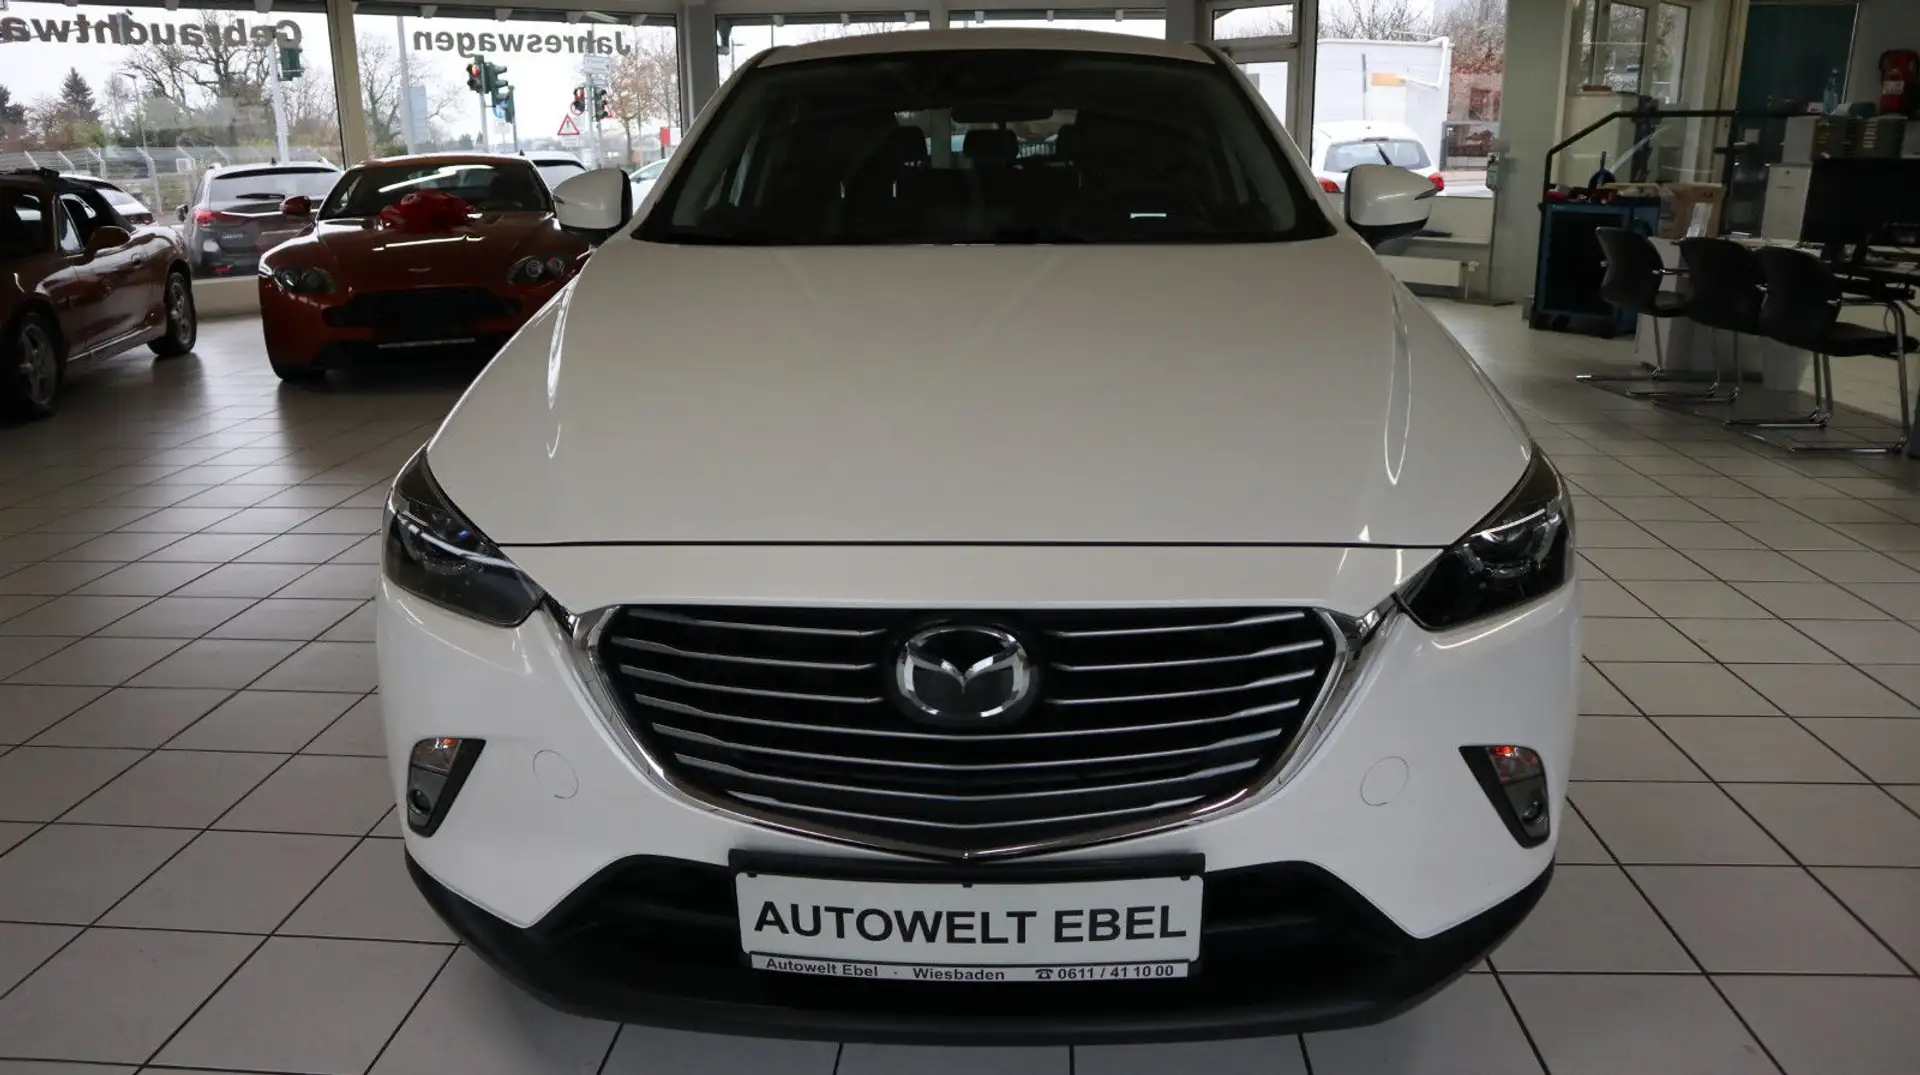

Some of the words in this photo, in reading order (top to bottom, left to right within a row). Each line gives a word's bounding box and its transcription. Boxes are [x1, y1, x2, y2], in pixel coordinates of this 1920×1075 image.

[754, 900, 1037, 944] AUTOWELT
[1054, 905, 1187, 943] EBEL
[766, 958, 838, 974] Autowelt
[842, 964, 878, 977] Ebel
[912, 967, 1005, 981] Wiesbaden
[1058, 967, 1094, 979] 0611
[1110, 966, 1128, 978] 41
[1135, 964, 1151, 977] 10
[1155, 964, 1174, 977] 00
